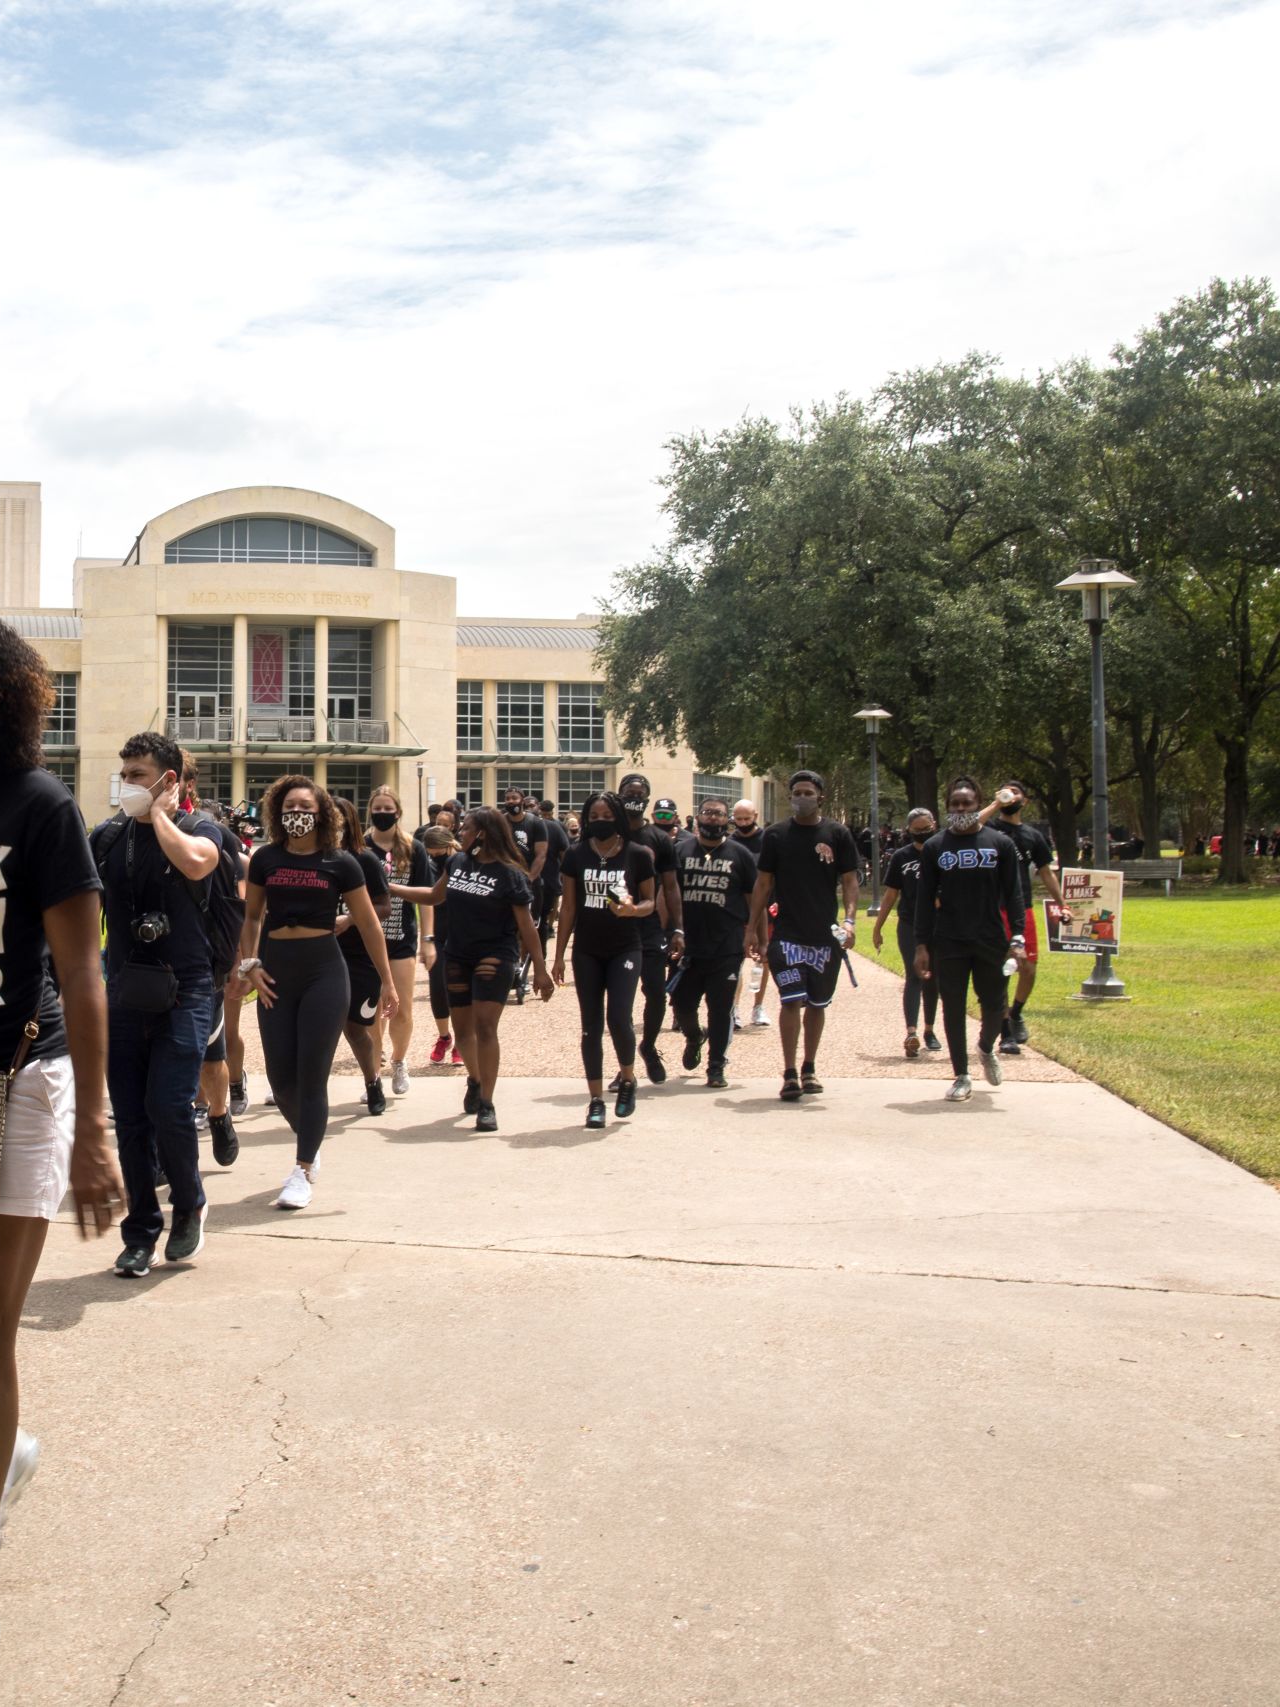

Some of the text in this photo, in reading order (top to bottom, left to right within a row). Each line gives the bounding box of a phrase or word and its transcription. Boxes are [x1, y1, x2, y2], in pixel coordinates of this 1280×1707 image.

[225, 591, 306, 604] ANDERSON
[312, 592, 372, 608] LIBRARY
[684, 856, 734, 873] BLACK
[584, 868, 626, 882] BLACK
[683, 873, 730, 891] LIVES
[1065, 875, 1086, 887] TAKE
[266, 876, 329, 889] EERLEADING
[585, 882, 618, 895] LIV
[1073, 887, 1096, 898] MAKE
[584, 895, 610, 909] MAT
